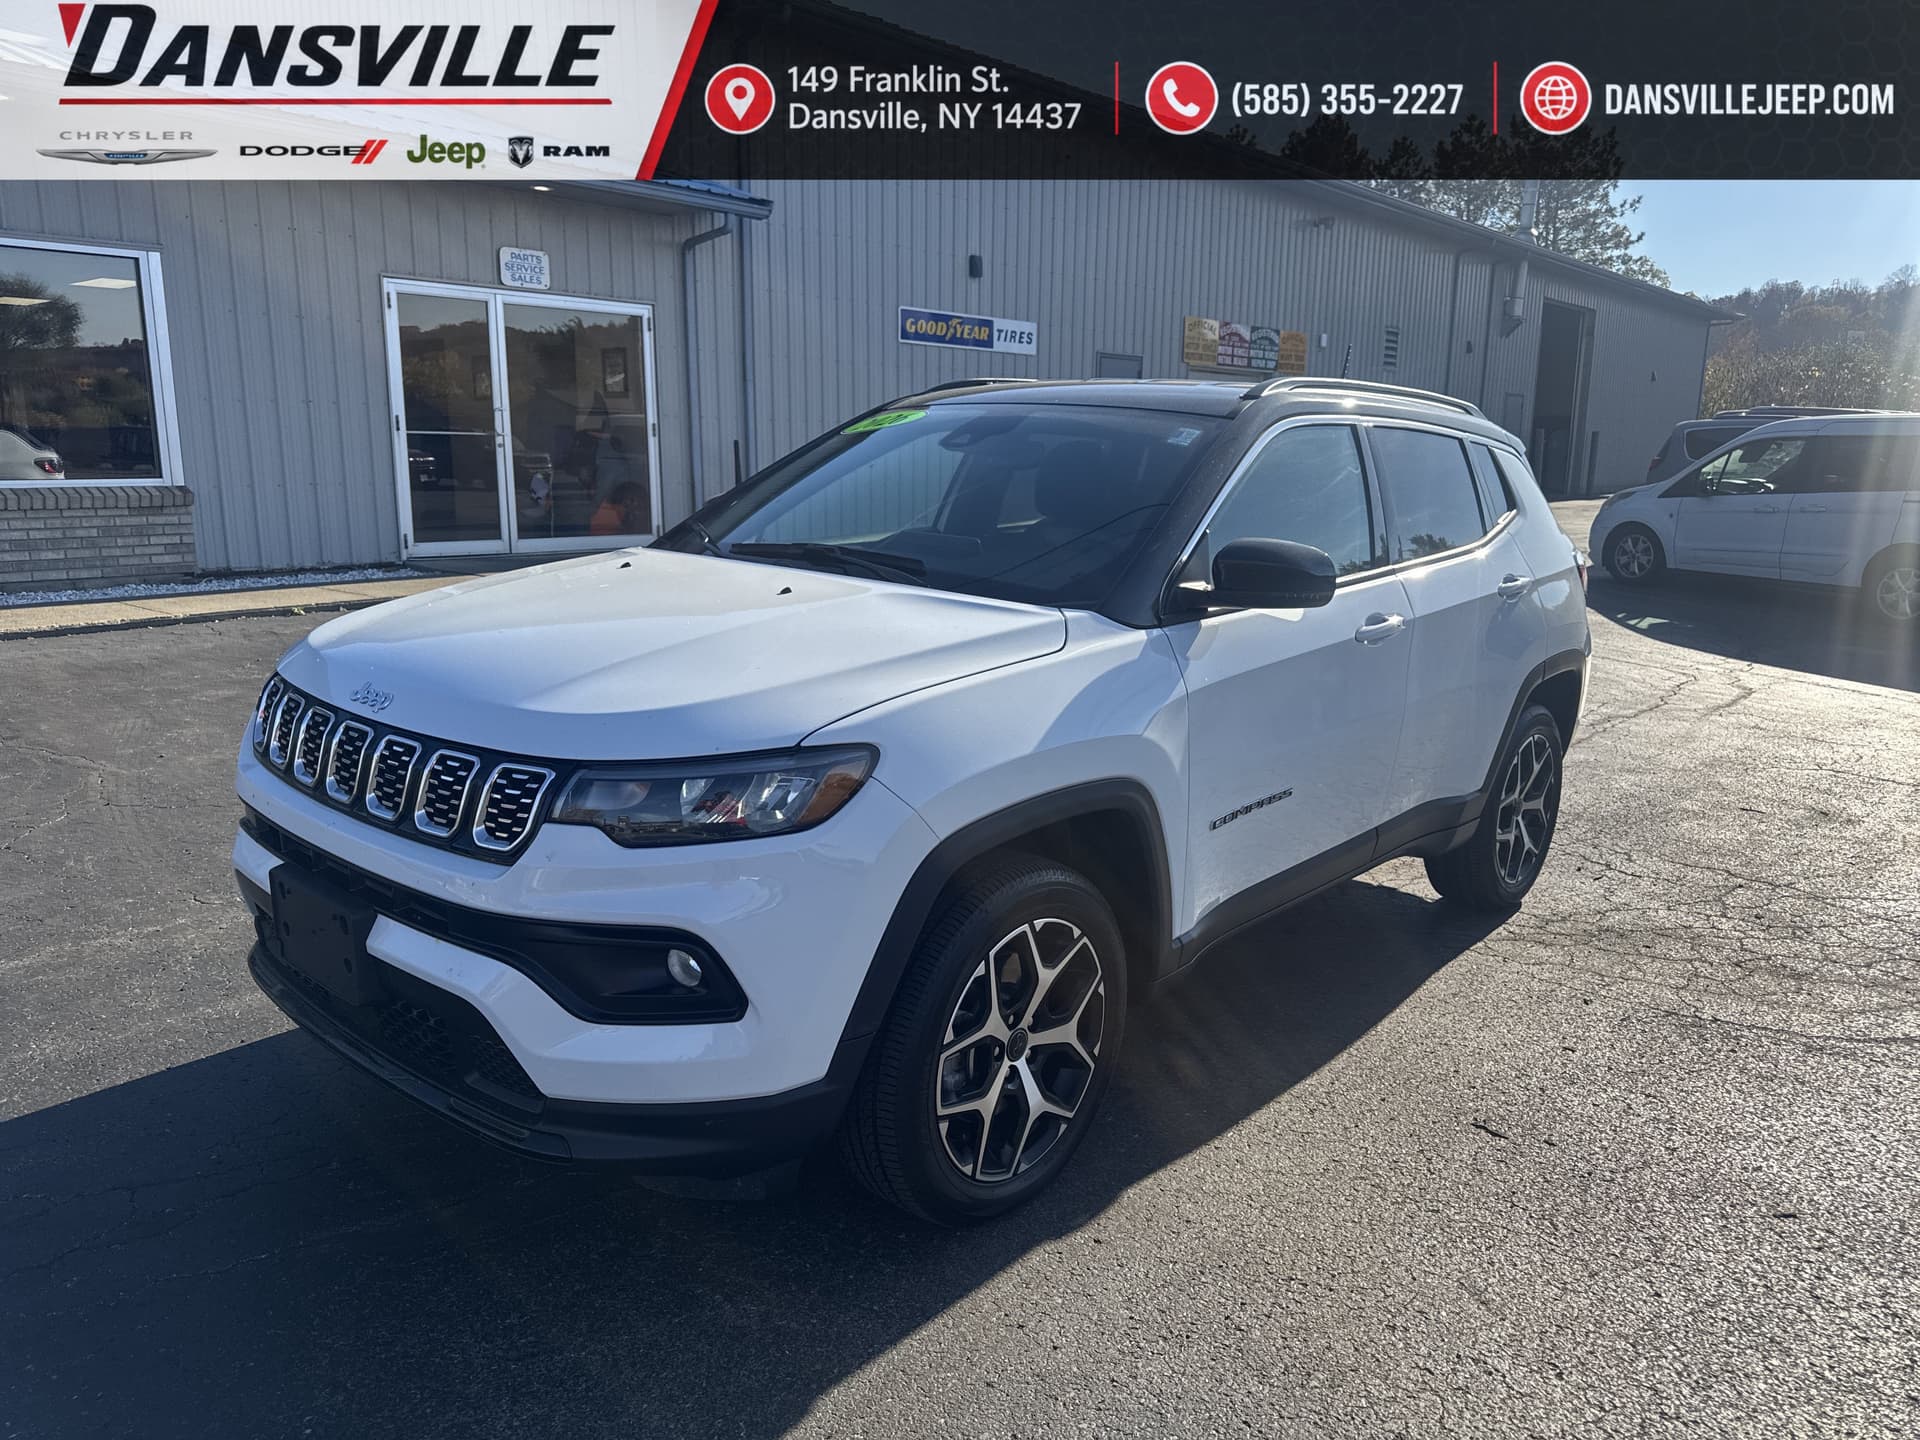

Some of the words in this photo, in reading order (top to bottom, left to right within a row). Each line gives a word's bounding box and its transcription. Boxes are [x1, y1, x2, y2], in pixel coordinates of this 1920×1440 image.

[510, 252, 543, 265] PARTS
[504, 262, 545, 275] SERVICE
[510, 273, 543, 285] SALES
[996, 328, 1034, 345] TIRES
[350, 680, 395, 714] Jeep
[1209, 787, 1294, 832] COMPASS
